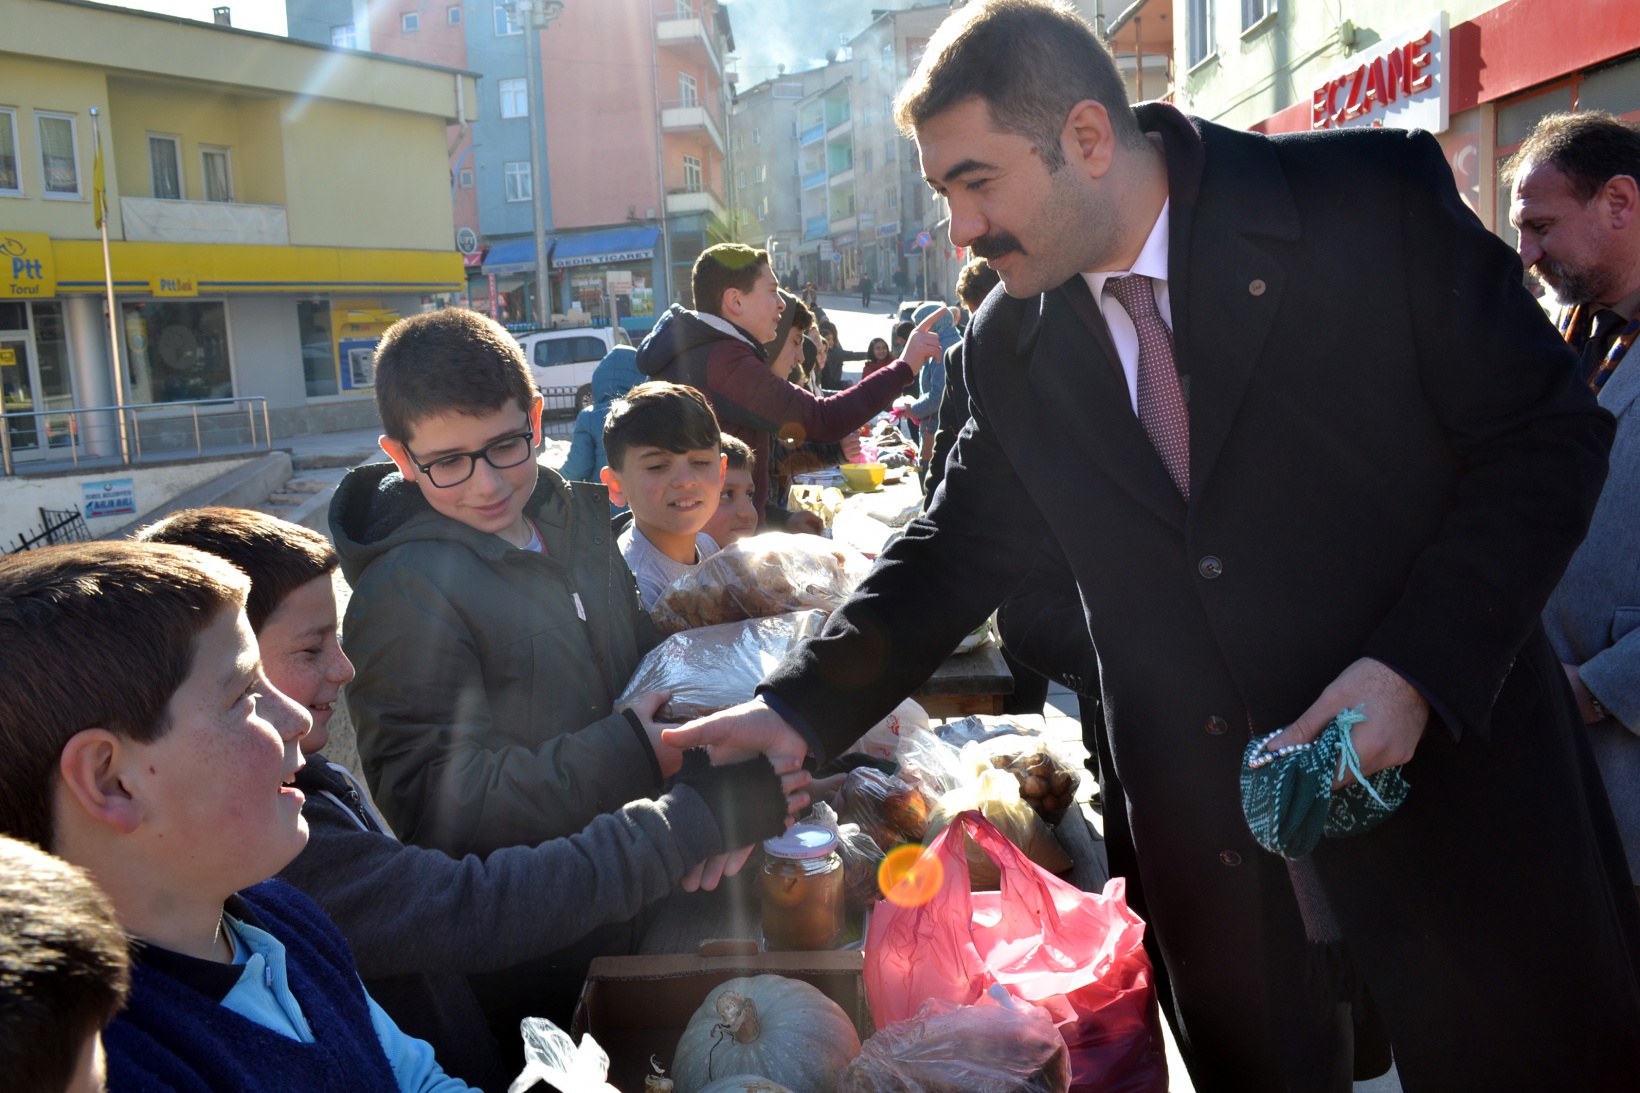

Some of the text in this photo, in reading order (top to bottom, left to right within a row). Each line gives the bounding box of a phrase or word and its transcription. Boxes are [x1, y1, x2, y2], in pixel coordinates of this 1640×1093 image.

[1313, 29, 1432, 130] ECZANE
[459, 236, 474, 246] UPT
[556, 251, 651, 267] GEDİK TİCARET
[12, 257, 43, 279] Ptt
[9, 284, 39, 295] Torul
